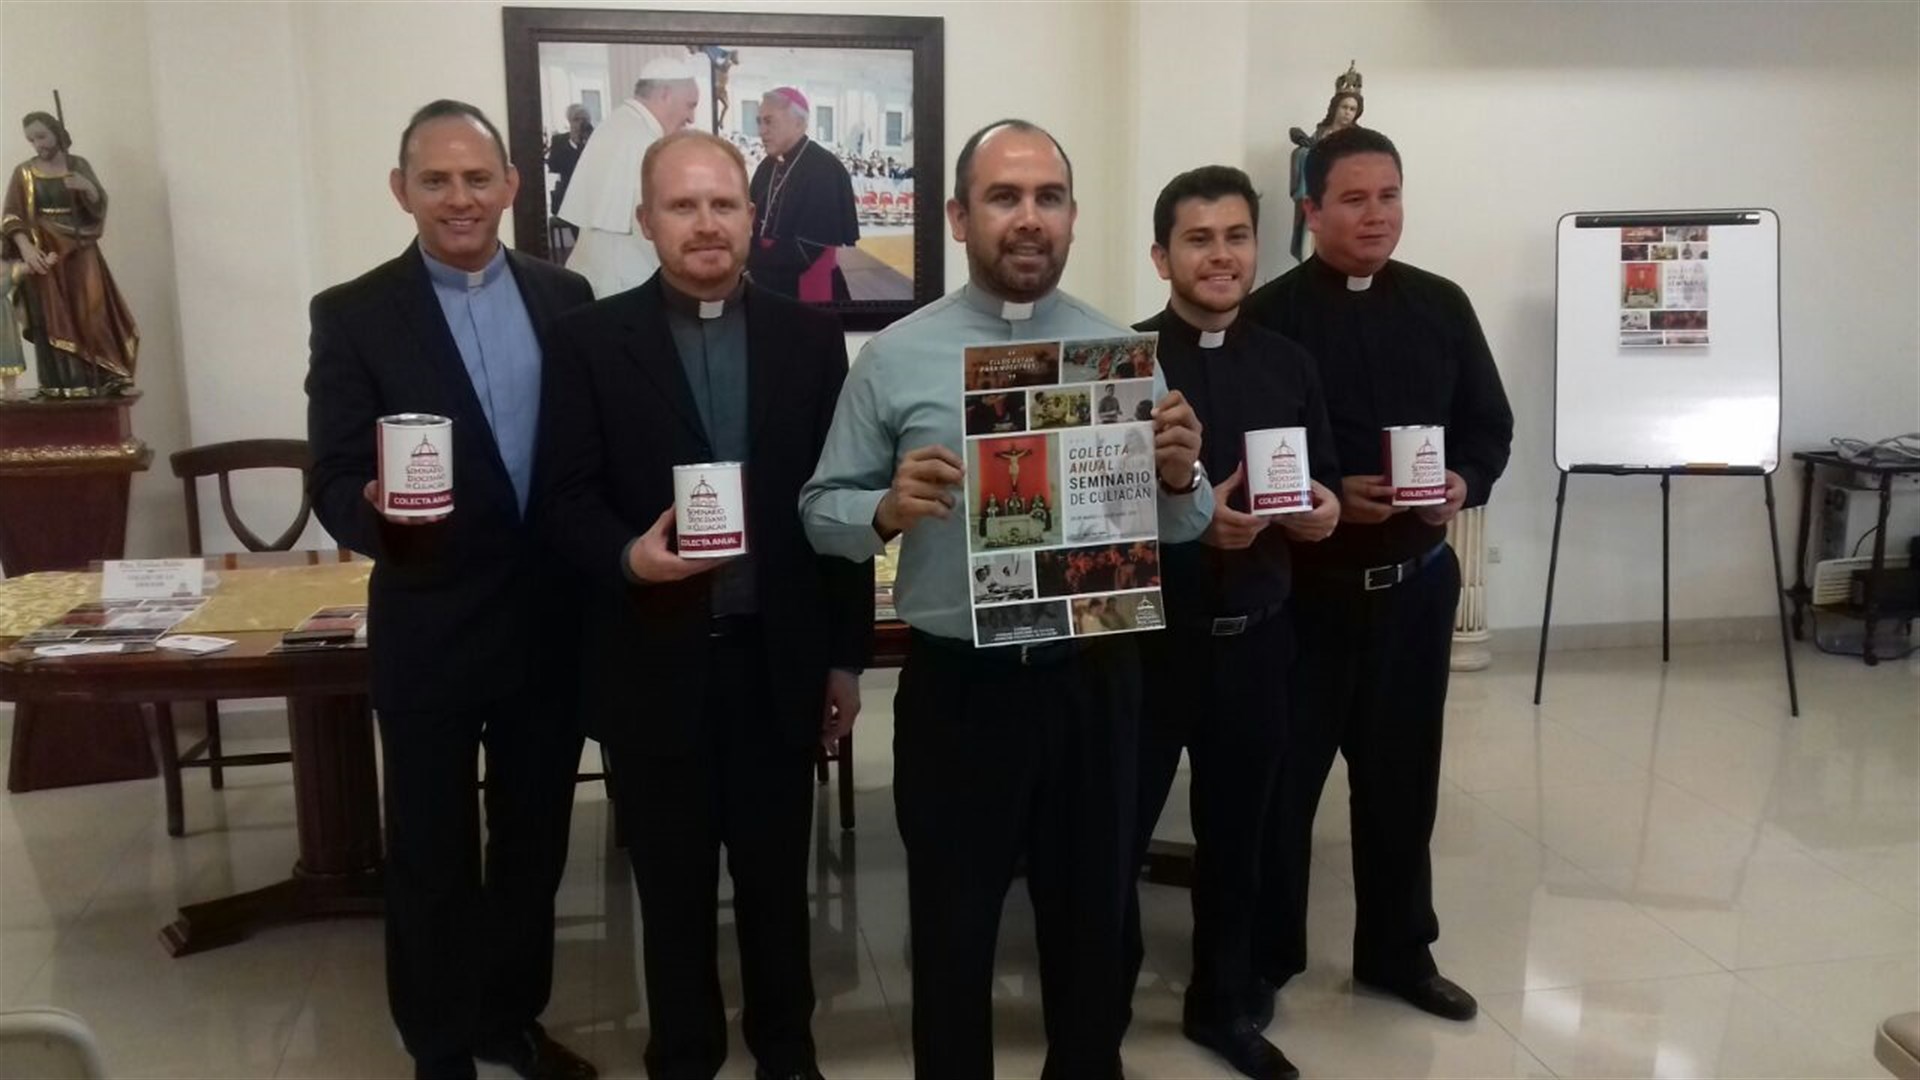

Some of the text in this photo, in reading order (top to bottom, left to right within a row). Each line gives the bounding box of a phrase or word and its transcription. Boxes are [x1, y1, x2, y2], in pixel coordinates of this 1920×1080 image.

[1069, 444, 1129, 460] COLECTA
[1069, 459, 1114, 474] ANUAL
[1069, 471, 1151, 490] SEMINARIO
[393, 497, 433, 505] COLECTA
[1070, 492, 1085, 505] DE
[1258, 496, 1292, 505] COLECTA
[680, 536, 739, 547] COLECTA ANUAL
